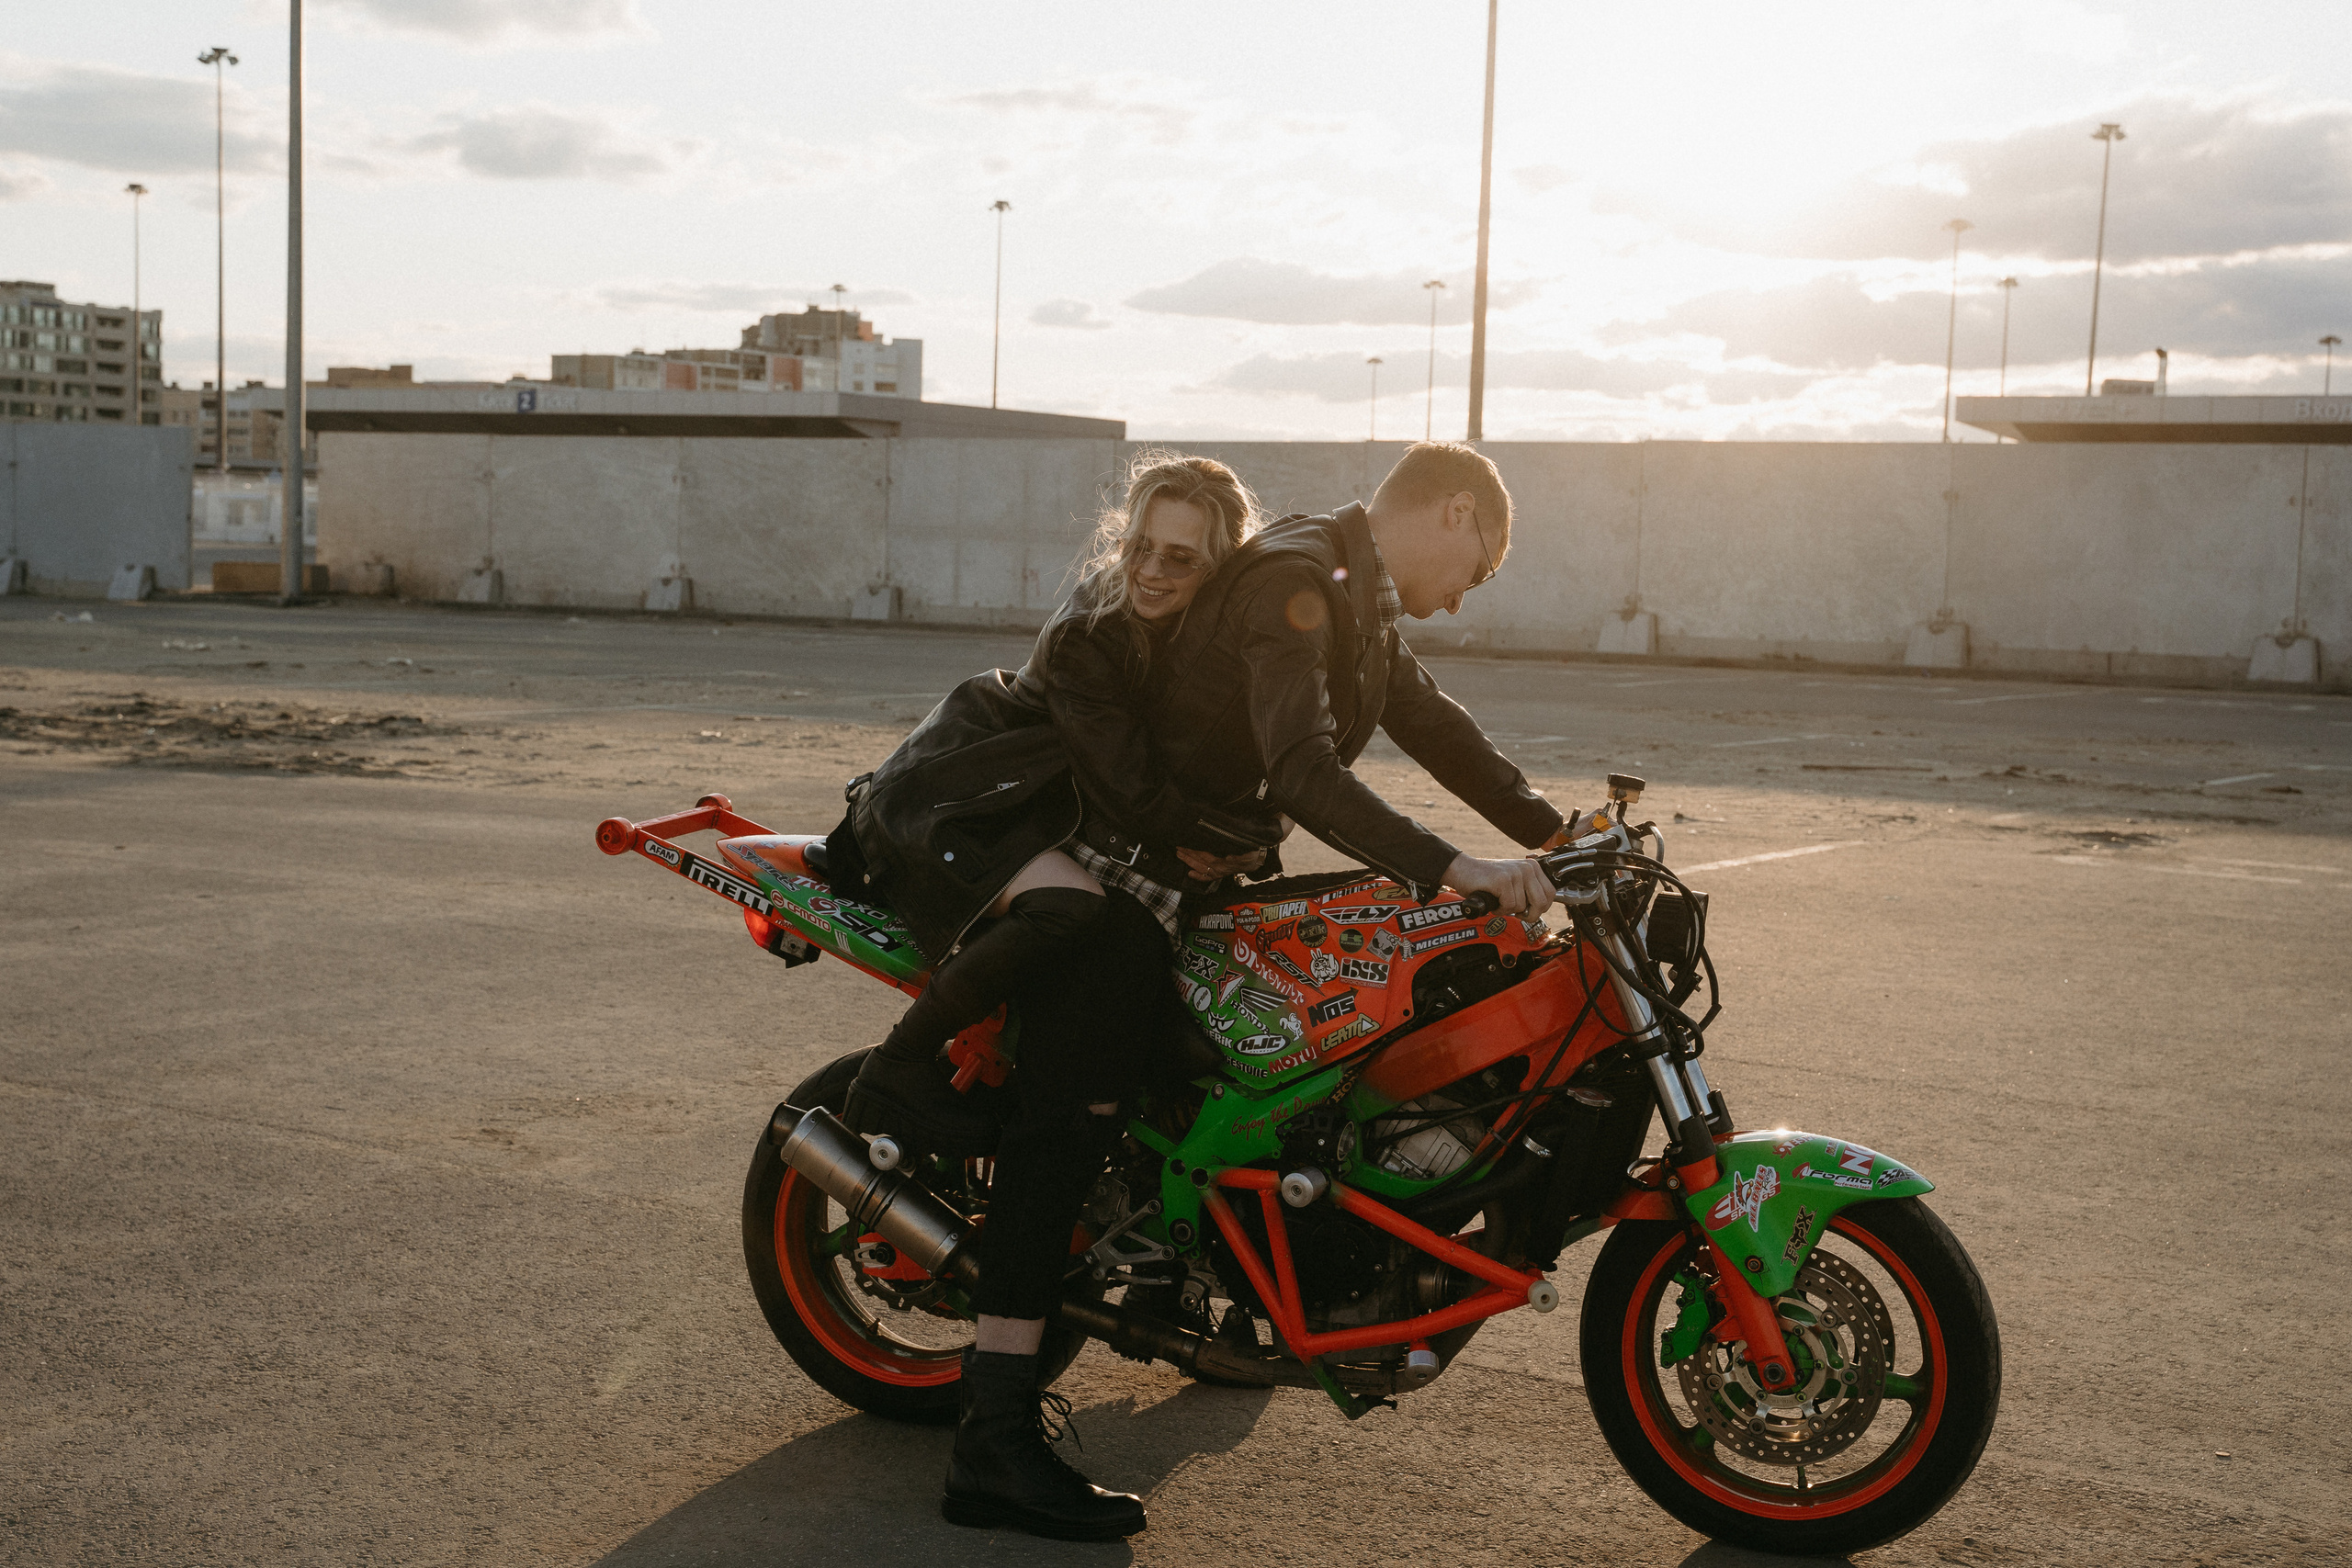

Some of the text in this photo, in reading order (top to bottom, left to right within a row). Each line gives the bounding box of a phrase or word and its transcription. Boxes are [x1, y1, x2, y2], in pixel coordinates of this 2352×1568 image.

[519, 392, 533, 409] 2
[649, 844, 675, 862] AFAM
[727, 844, 801, 892] Sports
[679, 852, 775, 918] PIRELLI
[786, 901, 831, 932] CFMOTO
[1323, 906, 1398, 920] FLY
[1401, 904, 1463, 930] FEROD
[1194, 935, 1226, 950] GoPro
[1416, 930, 1476, 951] MICHELIN
[1266, 951, 1322, 987] RST
[1340, 978, 1385, 989] MOTORCYCLE FASHION
[1230, 999, 1271, 1035] HONDA
[1307, 995, 1356, 1028] NOS
[1240, 1037, 1281, 1052] HJC
[1231, 1115, 1265, 1141] Enjoy
[1270, 1101, 1290, 1124] the
[1749, 1166, 1768, 1230] ALL BALLS
[1834, 1181, 1859, 1190] performing
[1781, 1204, 1817, 1267] FOX
